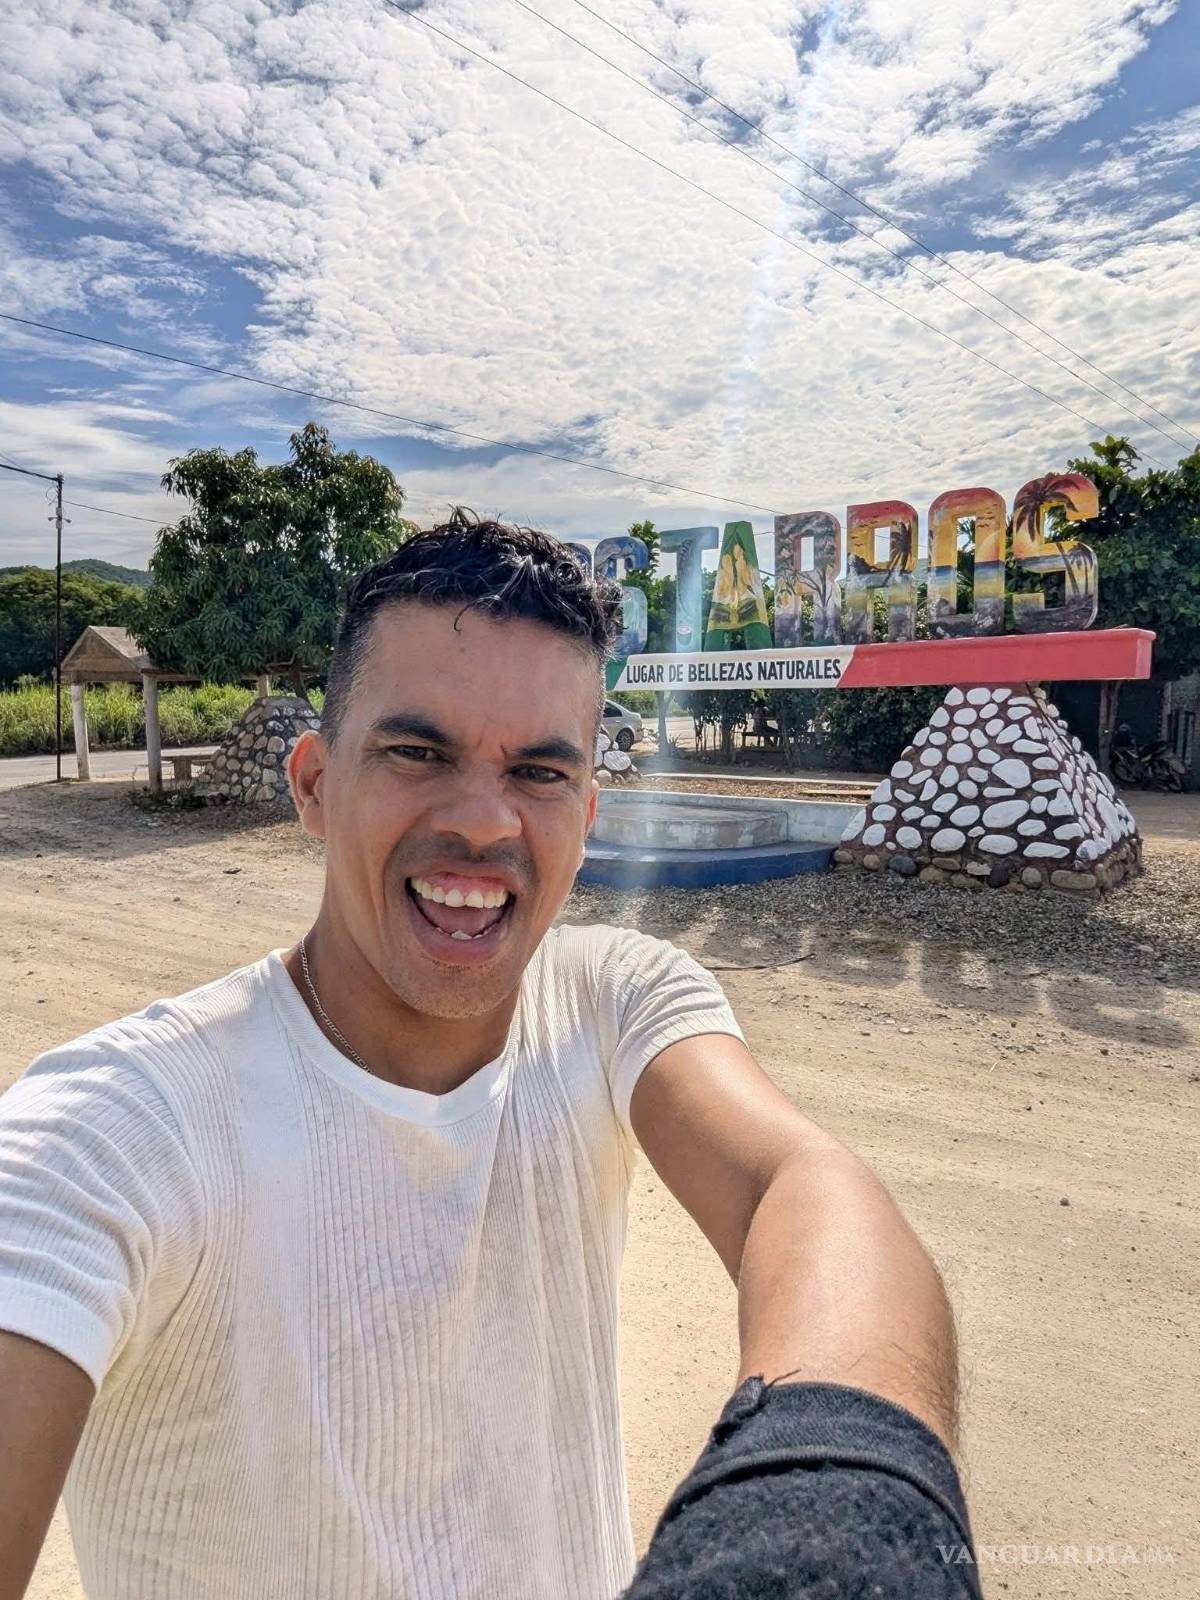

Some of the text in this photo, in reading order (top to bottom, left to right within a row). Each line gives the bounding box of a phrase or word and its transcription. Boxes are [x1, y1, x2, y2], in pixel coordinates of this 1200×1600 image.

[626, 658, 842, 684] LUGAR DE BELLEZAS NATURALES
